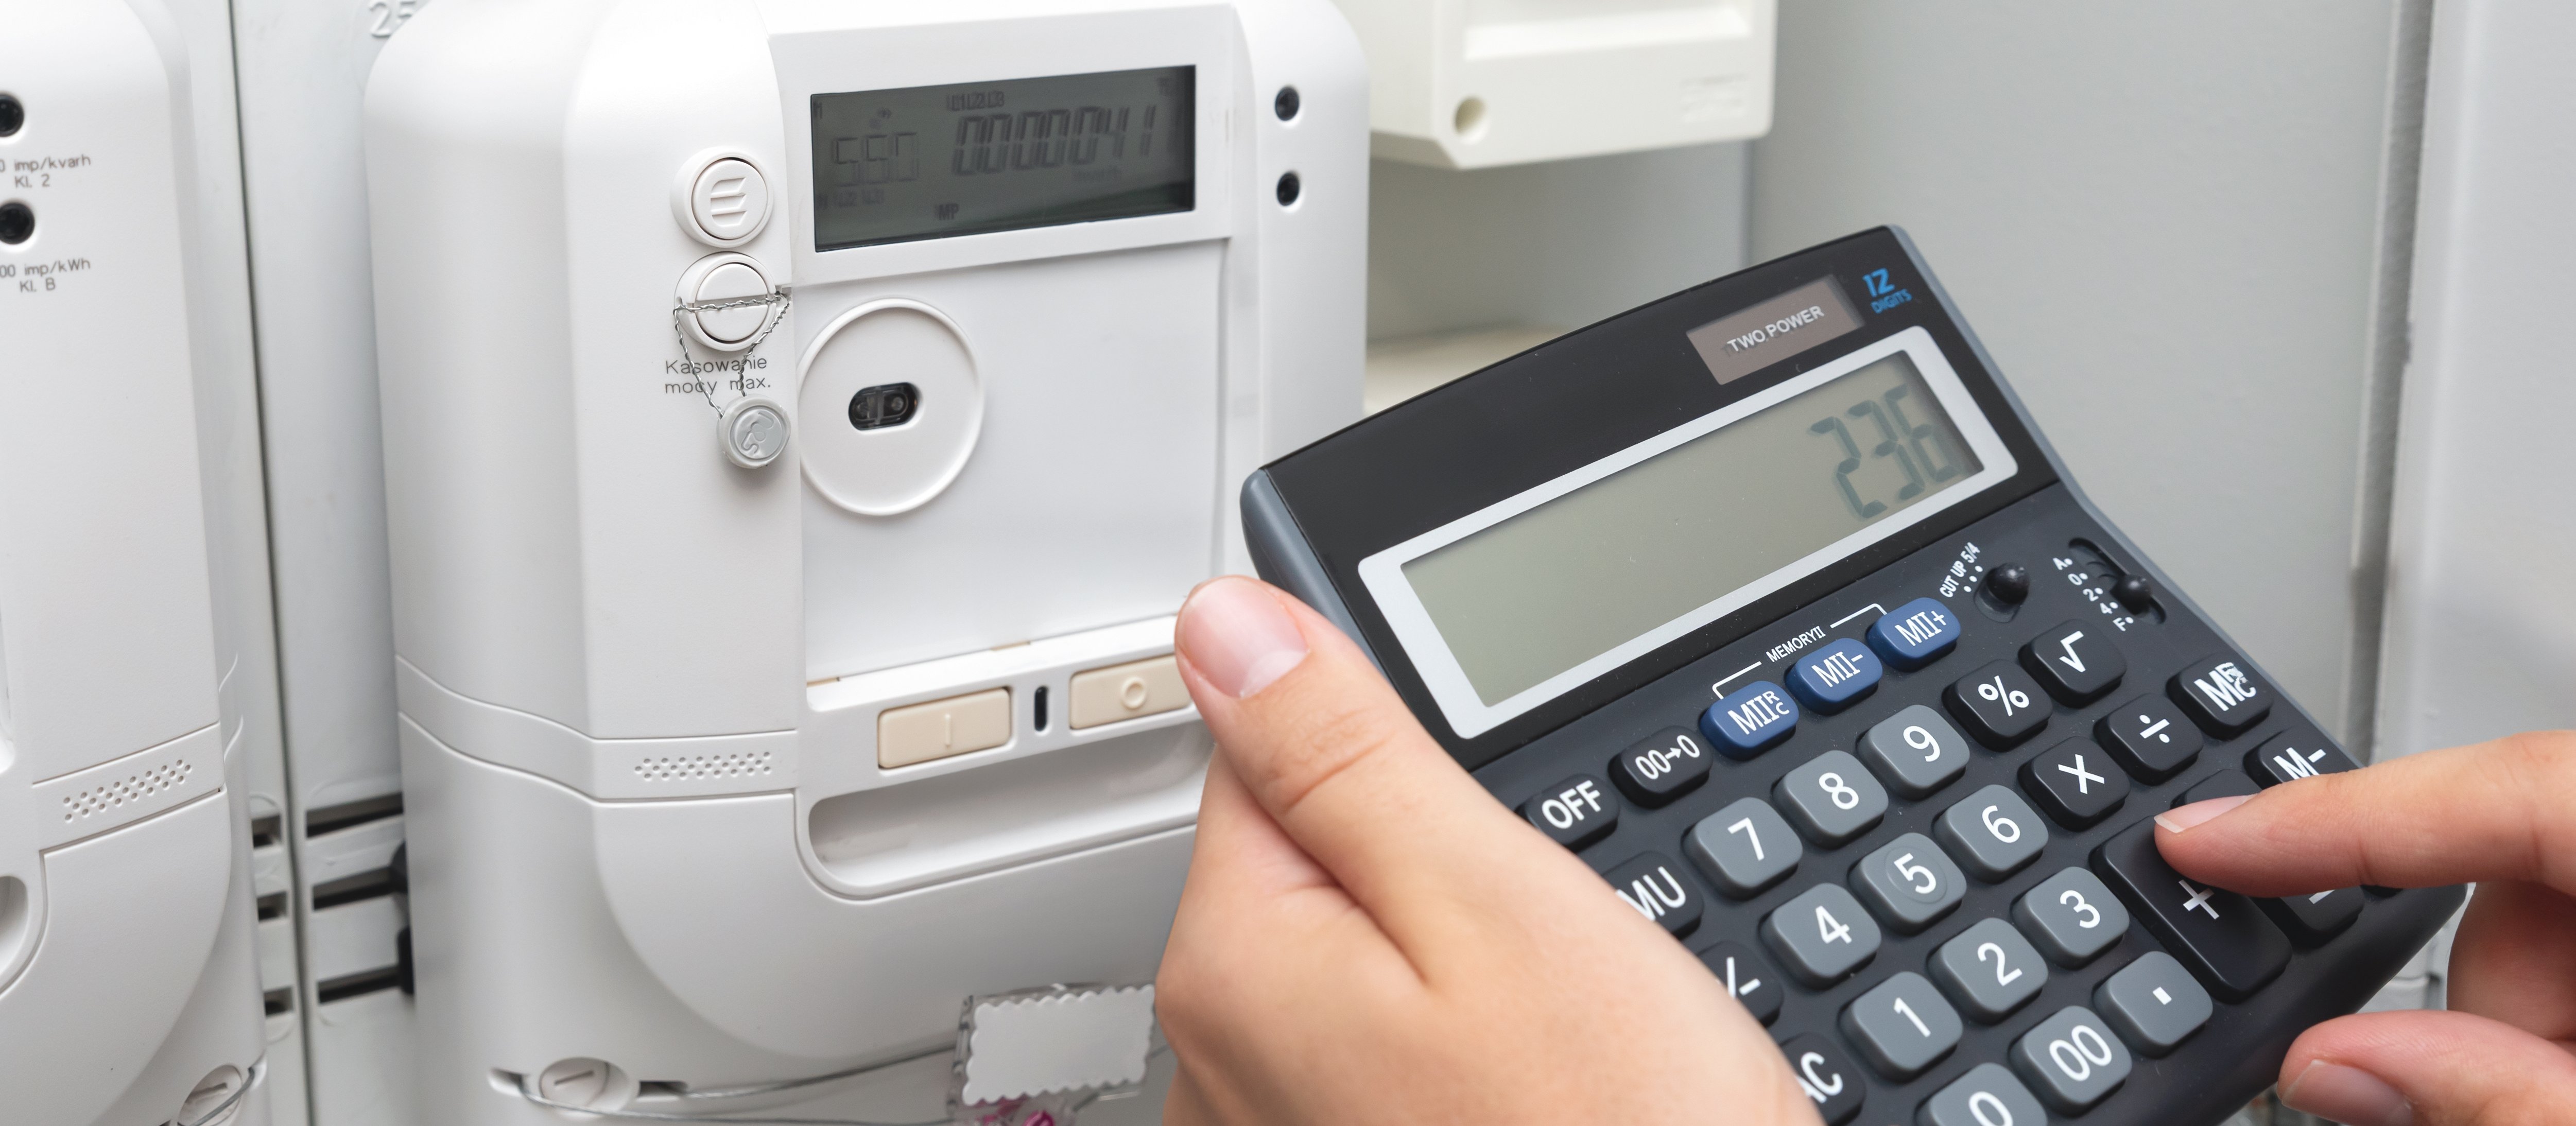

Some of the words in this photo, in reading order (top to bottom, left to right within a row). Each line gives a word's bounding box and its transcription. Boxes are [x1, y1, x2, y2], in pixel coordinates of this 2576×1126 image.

[14, 154, 91, 173] imp/kvarh
[41, 174, 50, 187] 2
[25, 258, 91, 276] imp/kWh
[45, 278, 56, 291] B
[1862, 268, 1895, 297] 12
[1871, 289, 1912, 314] DIGITS
[1727, 330, 1766, 351] TWO
[1765, 306, 1824, 337] POWER
[666, 355, 767, 374] Kasowanie
[1808, 385, 1961, 518] 236
[1940, 575, 1959, 597] CUT
[1950, 561, 1966, 577] UP
[1961, 542, 1980, 563] 5/4
[2083, 588, 2098, 601] 2
[2100, 603, 2113, 614] 4
[1978, 675, 2029, 717] %
[1903, 725, 1941, 762] 9
[1542, 780, 1601, 828] OFF
[1818, 772, 1859, 810] 8
[1727, 817, 1765, 861] 7
[1982, 805, 2020, 843] 6
[1893, 853, 1937, 894] 5
[1815, 905, 1852, 944] 4
[2060, 890, 2101, 929] 3
[1977, 942, 2022, 986] 2
[1893, 997, 1931, 1037] 1
[2049, 1025, 2112, 1082] 00
[1968, 1091, 2013, 1126] 0
